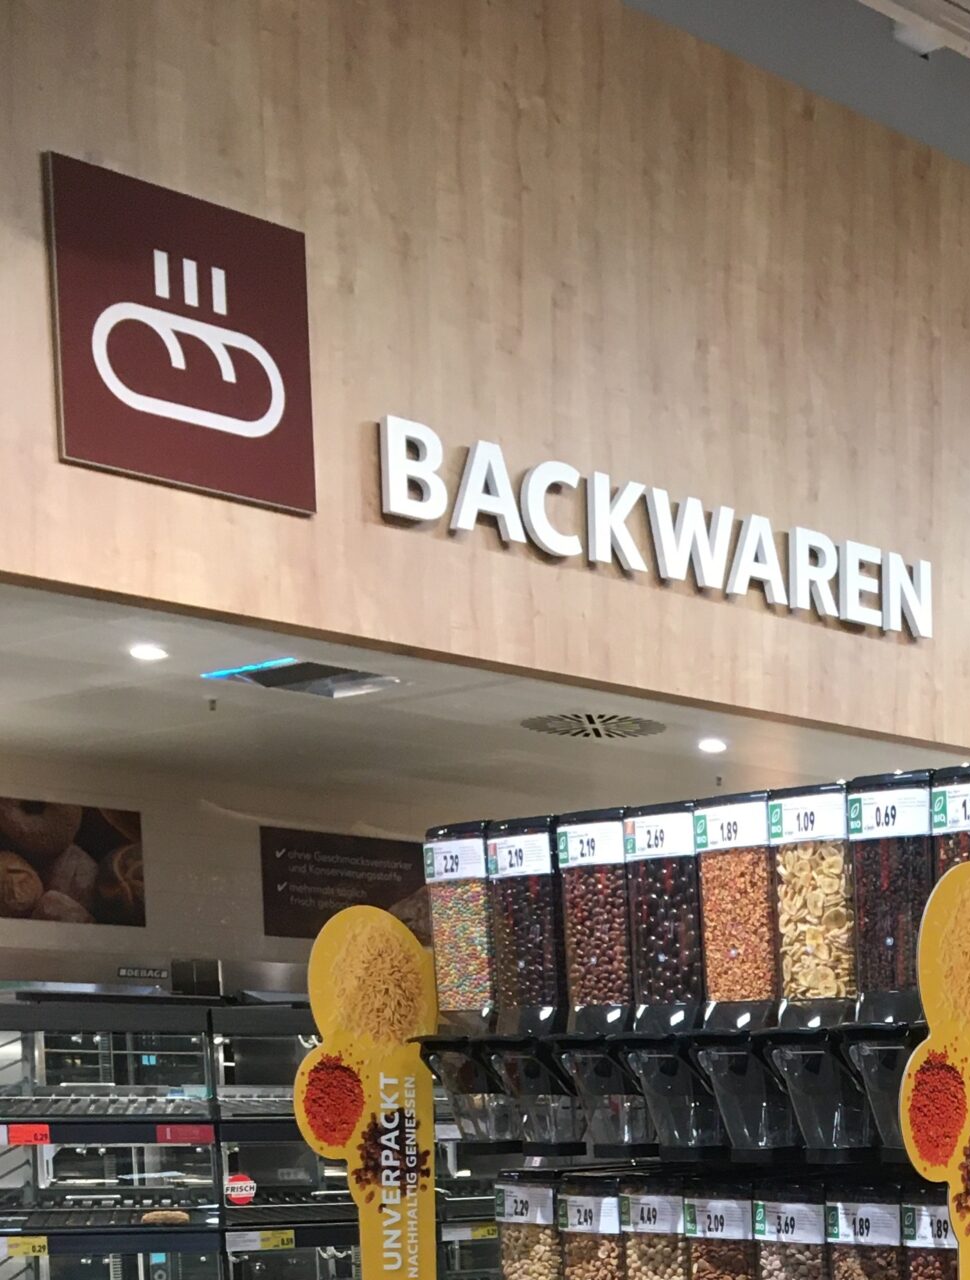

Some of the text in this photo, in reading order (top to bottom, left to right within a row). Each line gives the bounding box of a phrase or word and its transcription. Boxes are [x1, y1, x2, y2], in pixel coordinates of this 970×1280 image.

[380, 415, 933, 639] BACKWAREN
[796, 811, 815, 832] 1.09
[875, 805, 897, 827] 0.69
[934, 815, 945, 823] BIO
[647, 829, 664, 848] 2.69
[720, 821, 738, 841] 1.89
[288, 851, 311, 860] ohne
[579, 838, 595, 857] 2.19
[443, 855, 459, 873] 2.29
[508, 848, 523, 868] 2.19
[404, 1074, 417, 1167] GENIESSEN.
[379, 1072, 403, 1272] UNVERPACKT
[225, 1184, 256, 1194] FRISCH
[513, 1199, 529, 1217] 2.29
[577, 1208, 593, 1226] 2.49
[640, 1207, 657, 1225] 4.49
[405, 1171, 419, 1278] NACHHALTIG
[707, 1214, 724, 1233] 2.09
[776, 1215, 796, 1235] 3.69
[852, 1217, 871, 1237] 1.89
[929, 1219, 949, 1239] 1.89
[32, 1244, 46, 1254] 0.29
